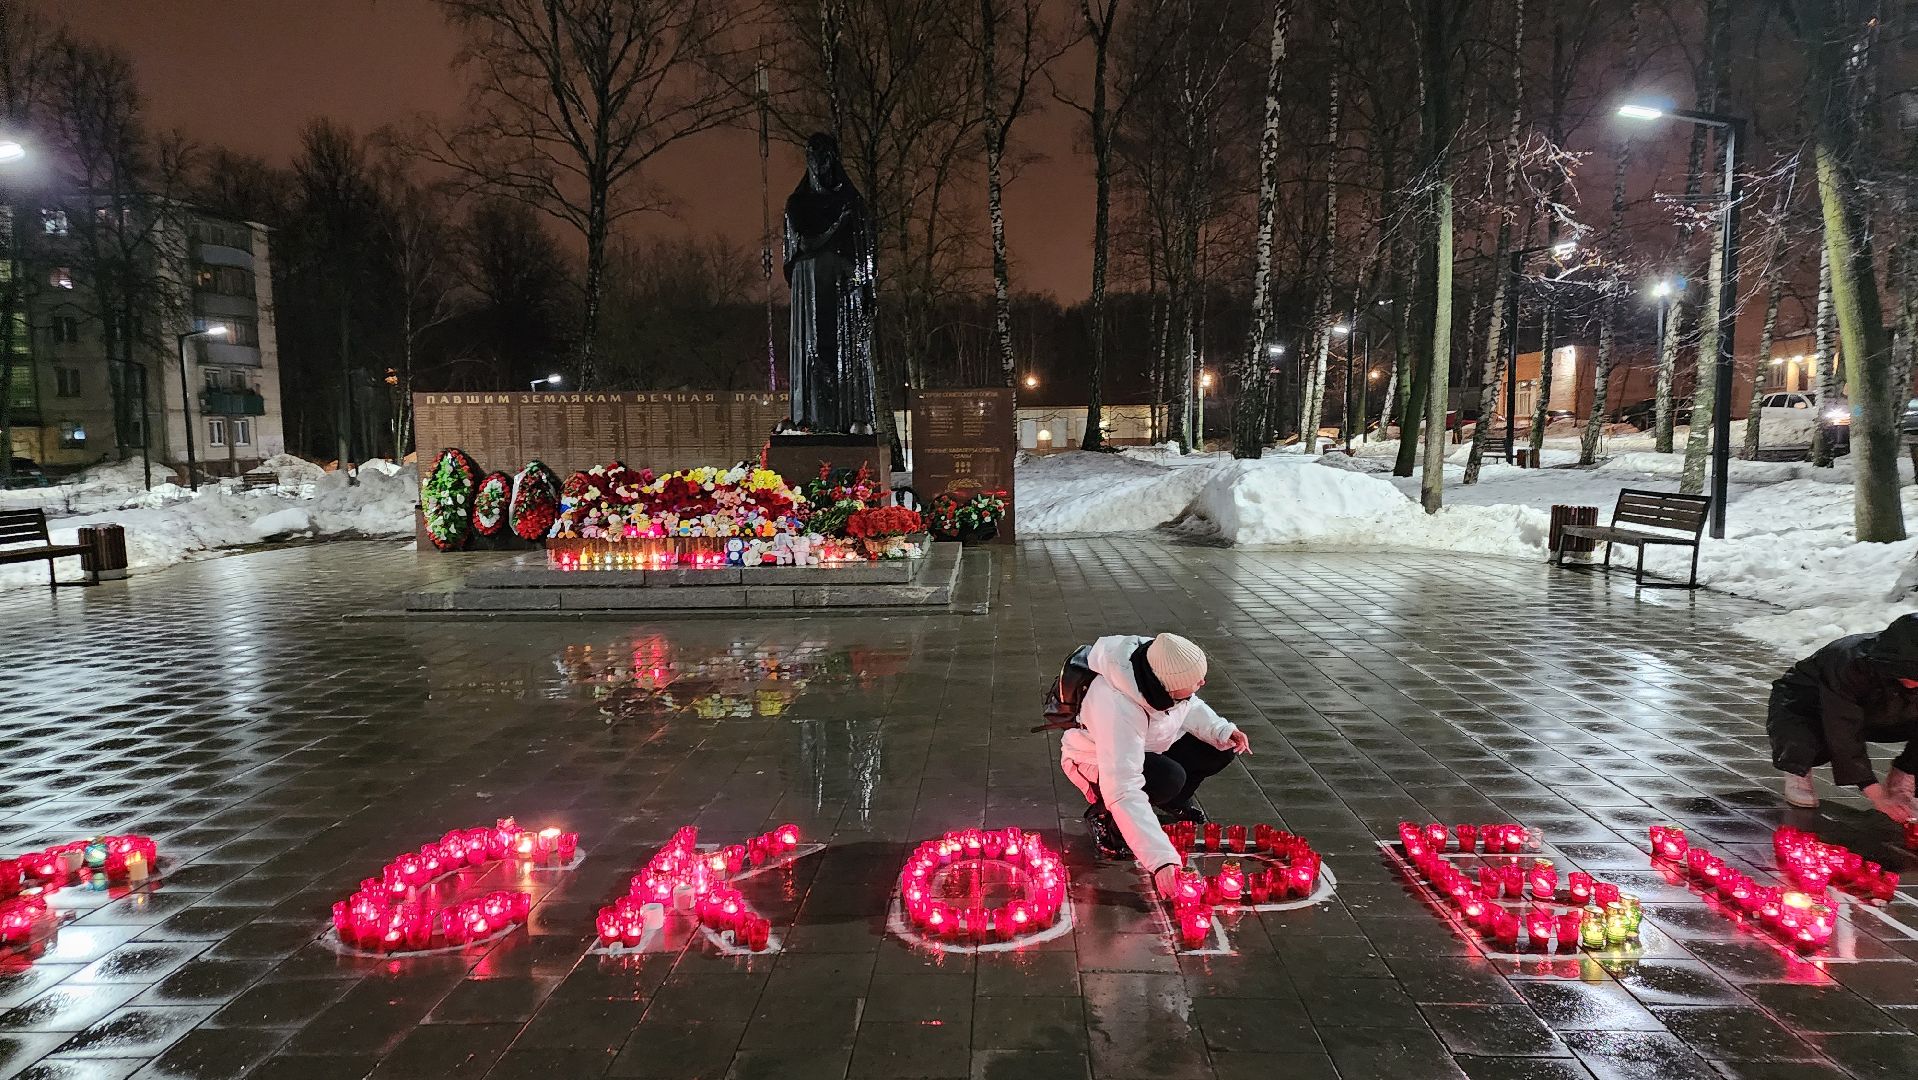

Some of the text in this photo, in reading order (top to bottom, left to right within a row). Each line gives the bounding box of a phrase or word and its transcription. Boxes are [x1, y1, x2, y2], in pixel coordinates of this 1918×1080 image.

[426, 395, 510, 404] ПАВШИМ
[521, 394, 622, 403] ЗЕМЛЯКАМ
[637, 394, 714, 402] ВЕЧНАЯ
